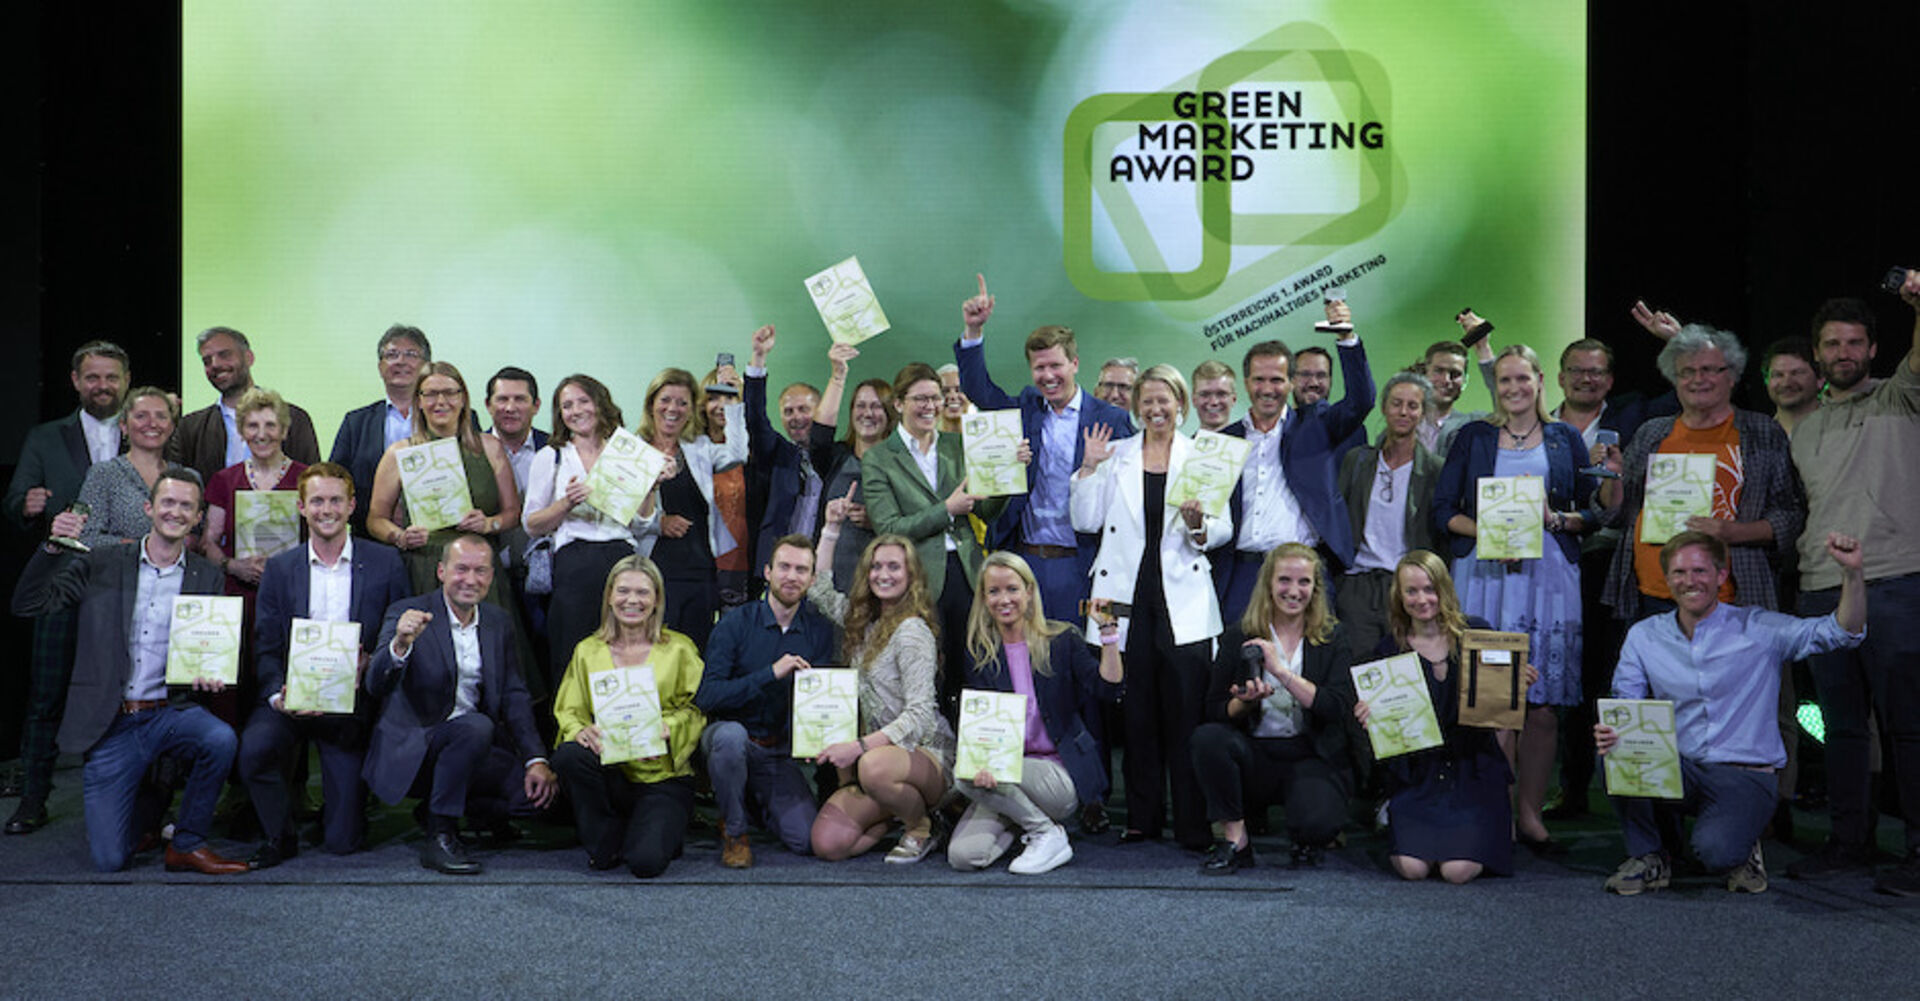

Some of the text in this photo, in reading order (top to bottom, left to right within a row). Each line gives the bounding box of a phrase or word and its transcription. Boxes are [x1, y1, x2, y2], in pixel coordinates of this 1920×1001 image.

[1173, 91, 1301, 118] GREEN
[1139, 122, 1384, 150] MARKETING
[1110, 155, 1255, 182] AWARD
[1203, 264, 1333, 338] ÖSTERREICHS 1. AWARD
[1210, 254, 1387, 351] FÜR NACHHALTIGES MARKETING
